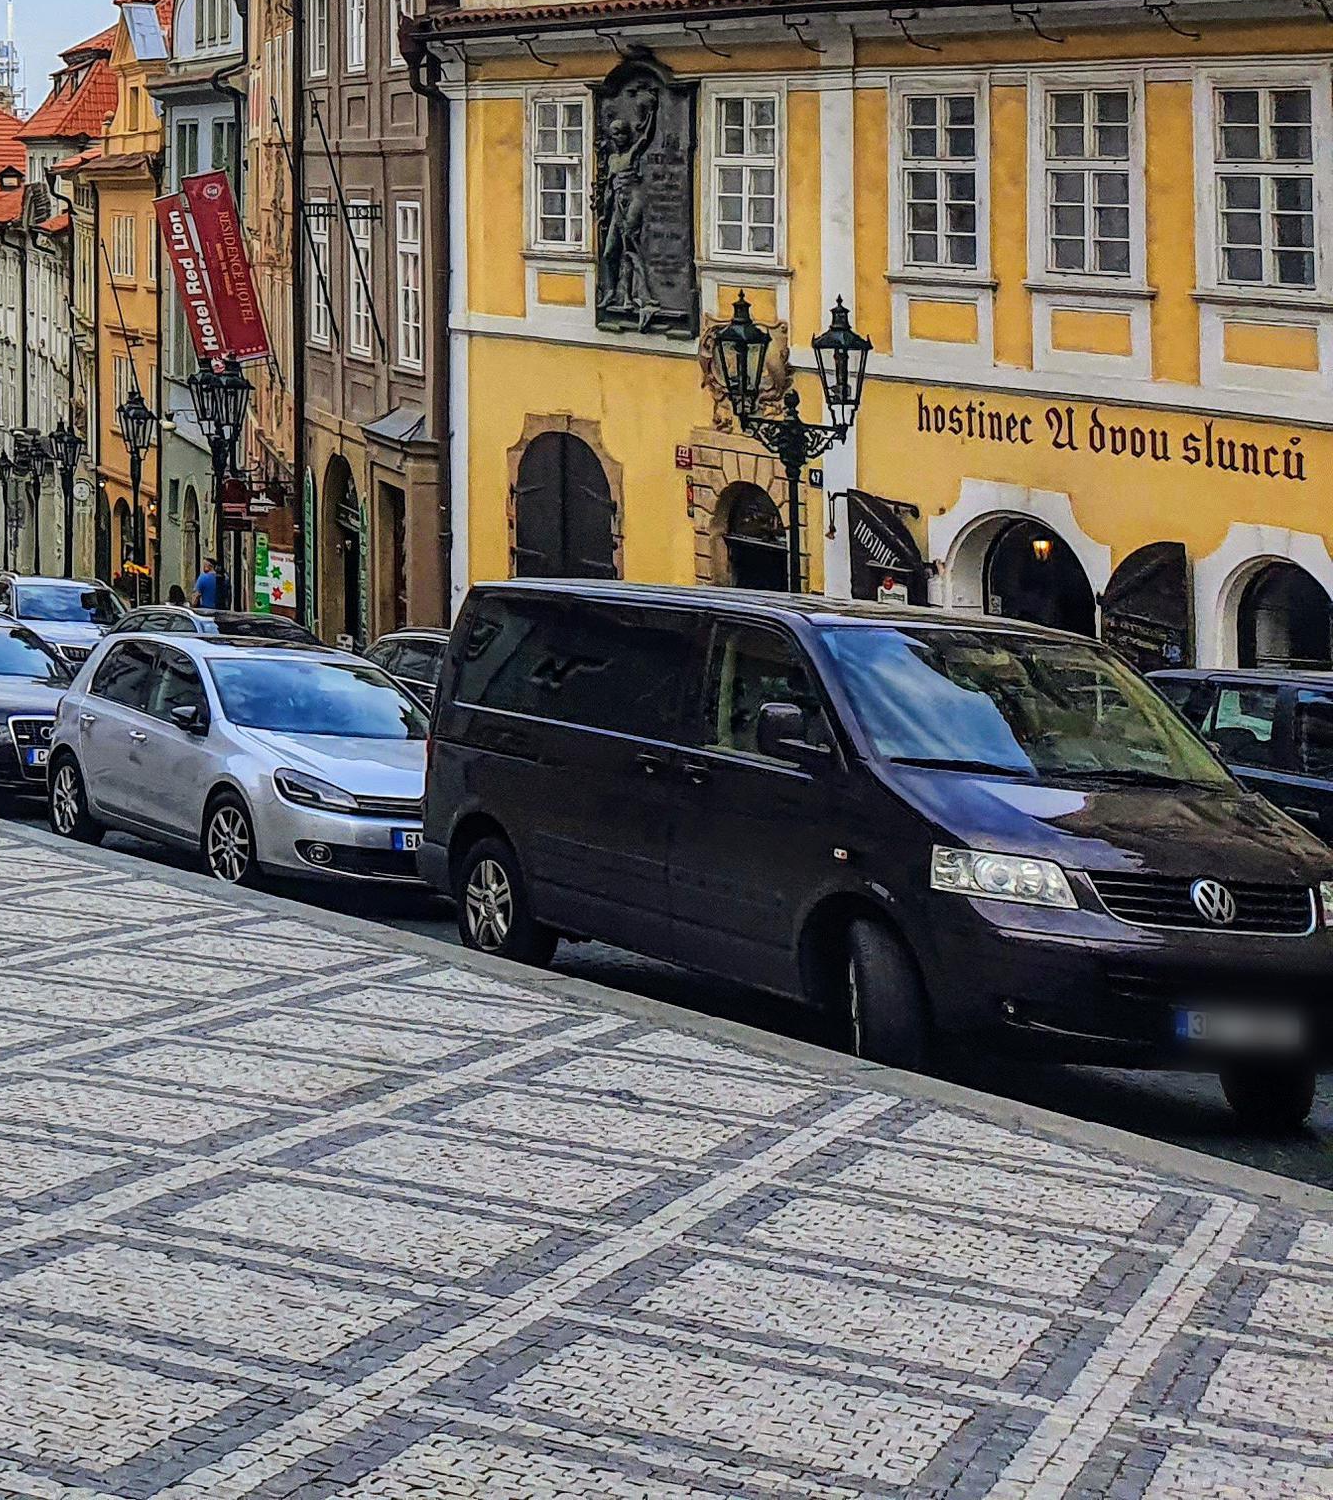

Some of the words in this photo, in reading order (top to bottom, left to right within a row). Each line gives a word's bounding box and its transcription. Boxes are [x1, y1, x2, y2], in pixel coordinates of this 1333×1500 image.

[168, 210, 189, 251] Lion
[178, 257, 202, 295] Red
[191, 300, 219, 351] Hotel
[917, 393, 1033, 445] hostinec
[1089, 408, 1171, 461] dvou
[1182, 419, 1307, 481] slunců
